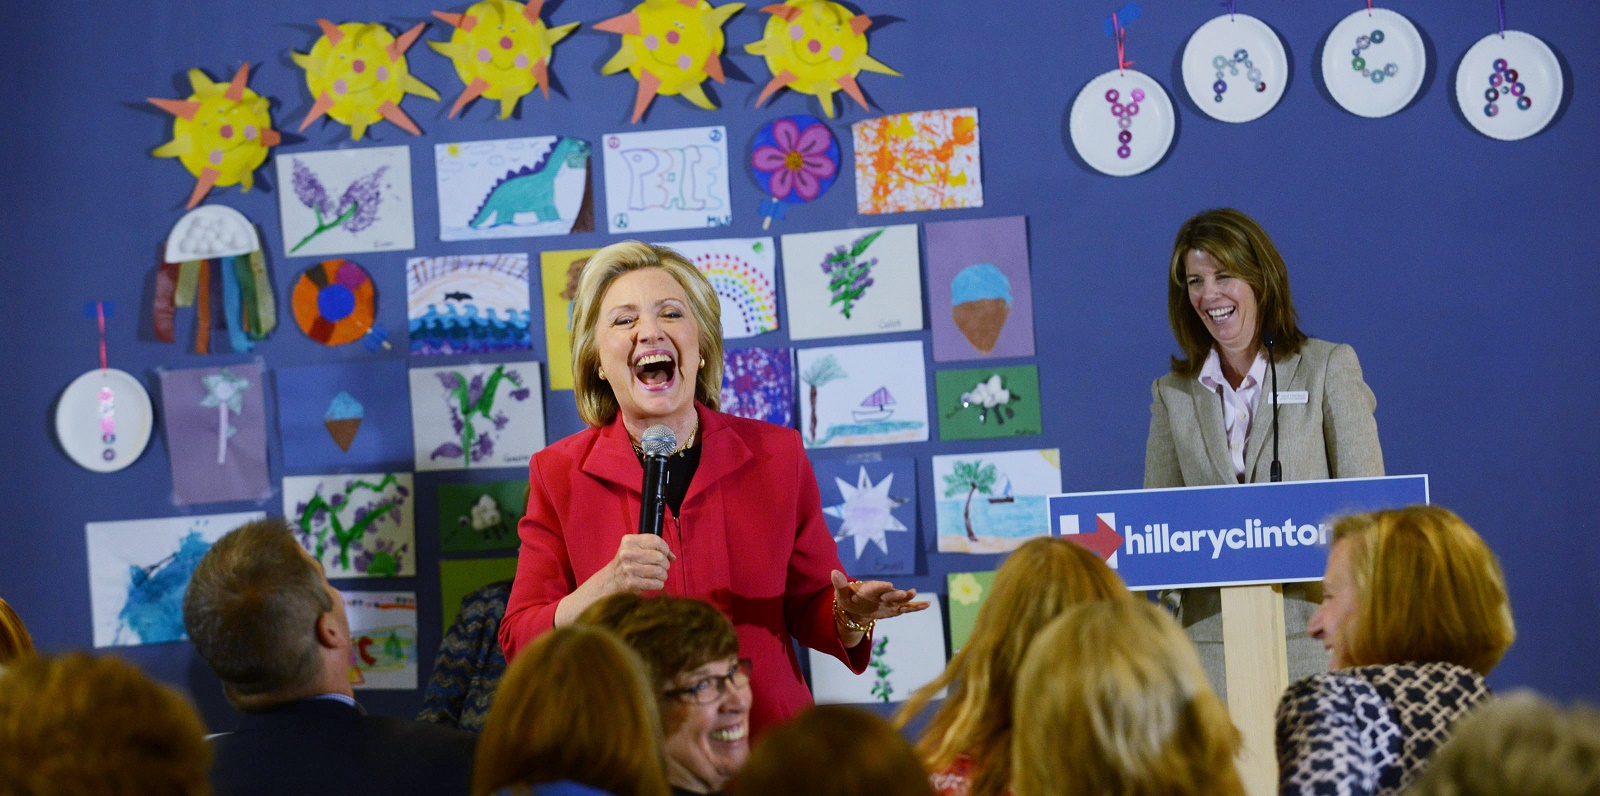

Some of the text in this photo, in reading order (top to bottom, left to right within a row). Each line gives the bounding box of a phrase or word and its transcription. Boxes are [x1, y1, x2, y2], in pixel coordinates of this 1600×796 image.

[1352, 29, 1398, 84] C
[1484, 58, 1532, 117] A
[1105, 88, 1145, 159] Y
